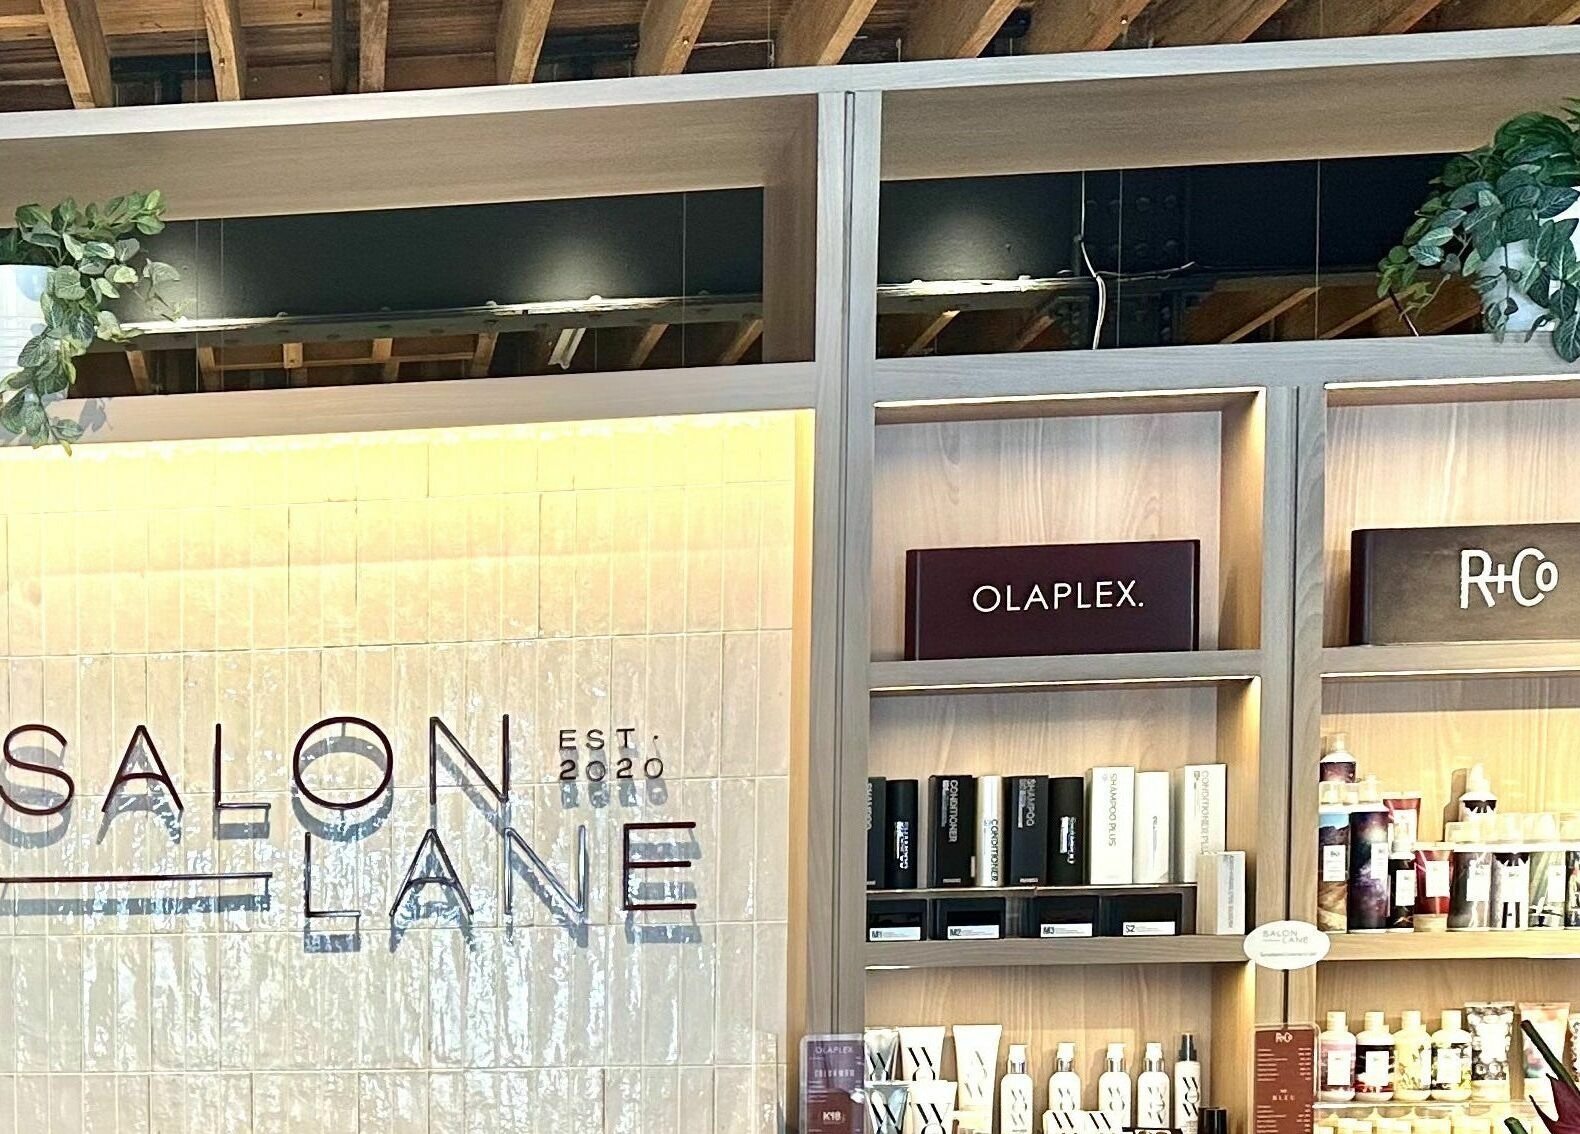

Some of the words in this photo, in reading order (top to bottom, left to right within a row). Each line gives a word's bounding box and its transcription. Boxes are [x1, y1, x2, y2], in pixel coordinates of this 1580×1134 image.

[971, 579, 1145, 613] OLAPLEX.
[1459, 547, 1559, 609] R+Co
[558, 728, 664, 750] EST.
[558, 756, 665, 781] 2020
[948, 780, 959, 843] CONDITIONER
[1026, 778, 1037, 827] SHAMPOO
[1108, 773, 1118, 822] SHAMPOO
[990, 818, 999, 882] CONDITIONER
[1108, 823, 1117, 847] PLUS
[303, 822, 697, 917] LANE
[1262, 929, 1298, 938] SALON
[1282, 936, 1309, 944] LANE
